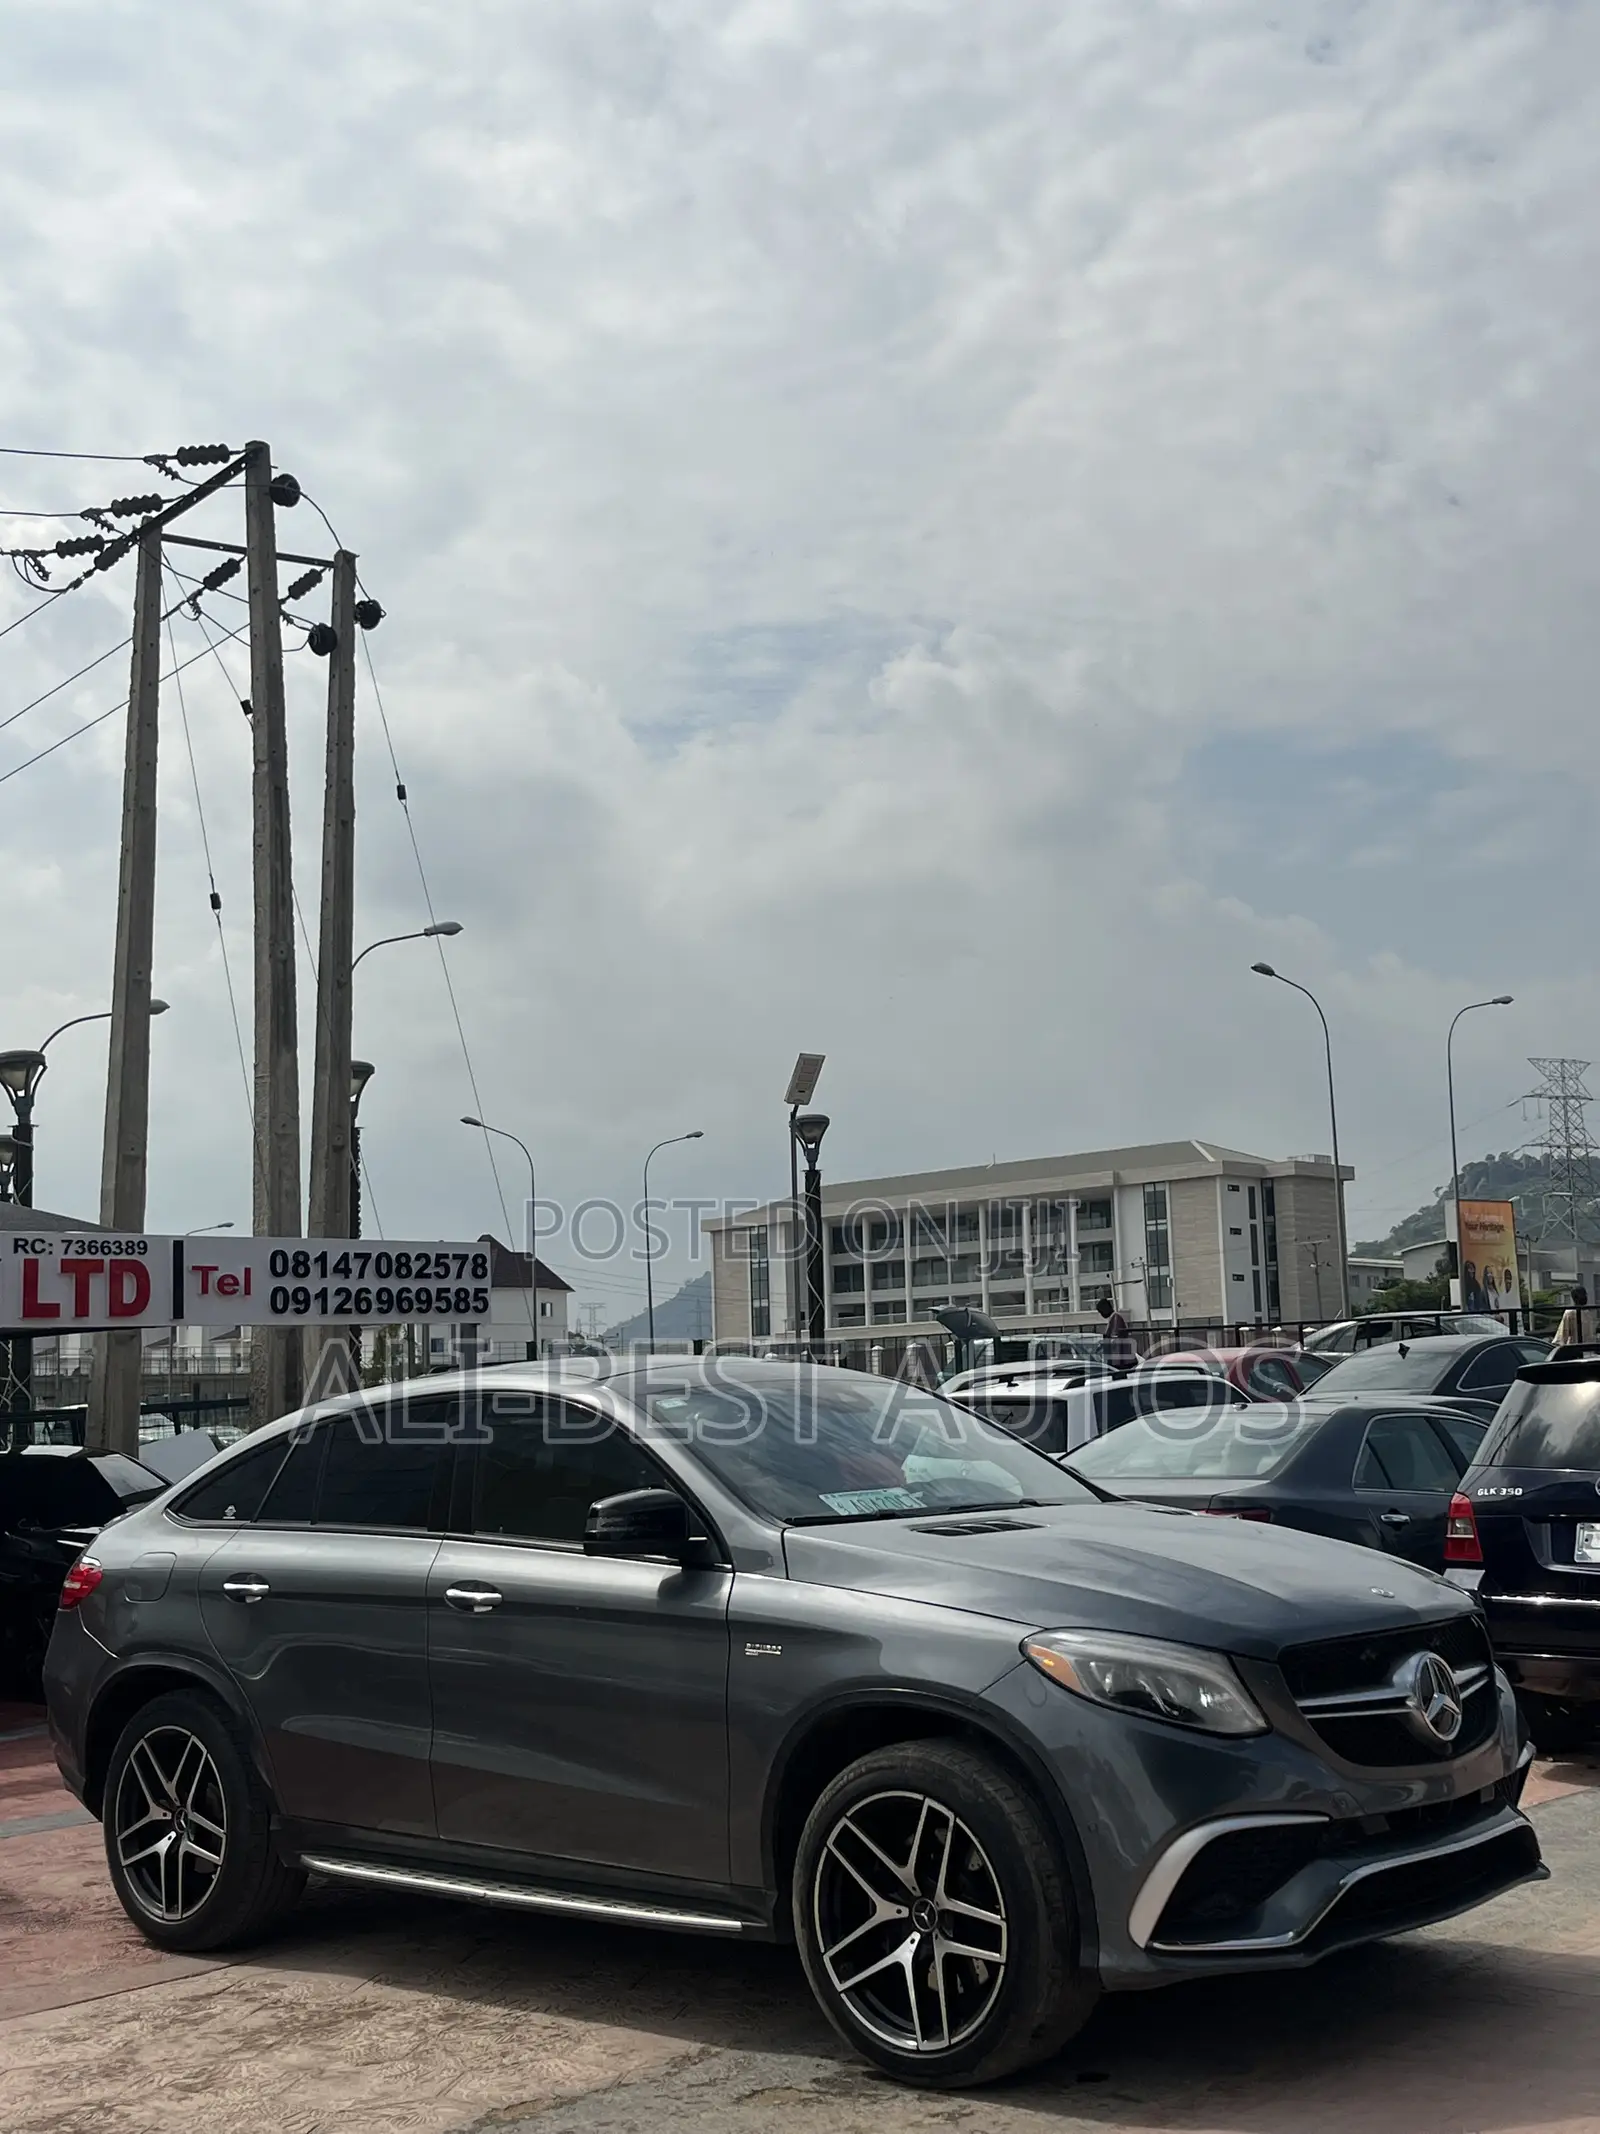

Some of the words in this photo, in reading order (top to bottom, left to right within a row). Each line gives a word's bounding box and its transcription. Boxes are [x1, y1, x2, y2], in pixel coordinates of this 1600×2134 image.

[13, 1238, 53, 1255] RC:
[60, 1239, 148, 1256] 7366389
[269, 1249, 488, 1280] 08147082578
[22, 1258, 151, 1318] LTD
[191, 1265, 252, 1296] Tel
[269, 1286, 489, 1315] 09126969585
[1477, 1487, 1497, 1496] GLK
[1499, 1487, 1523, 1496] 350
